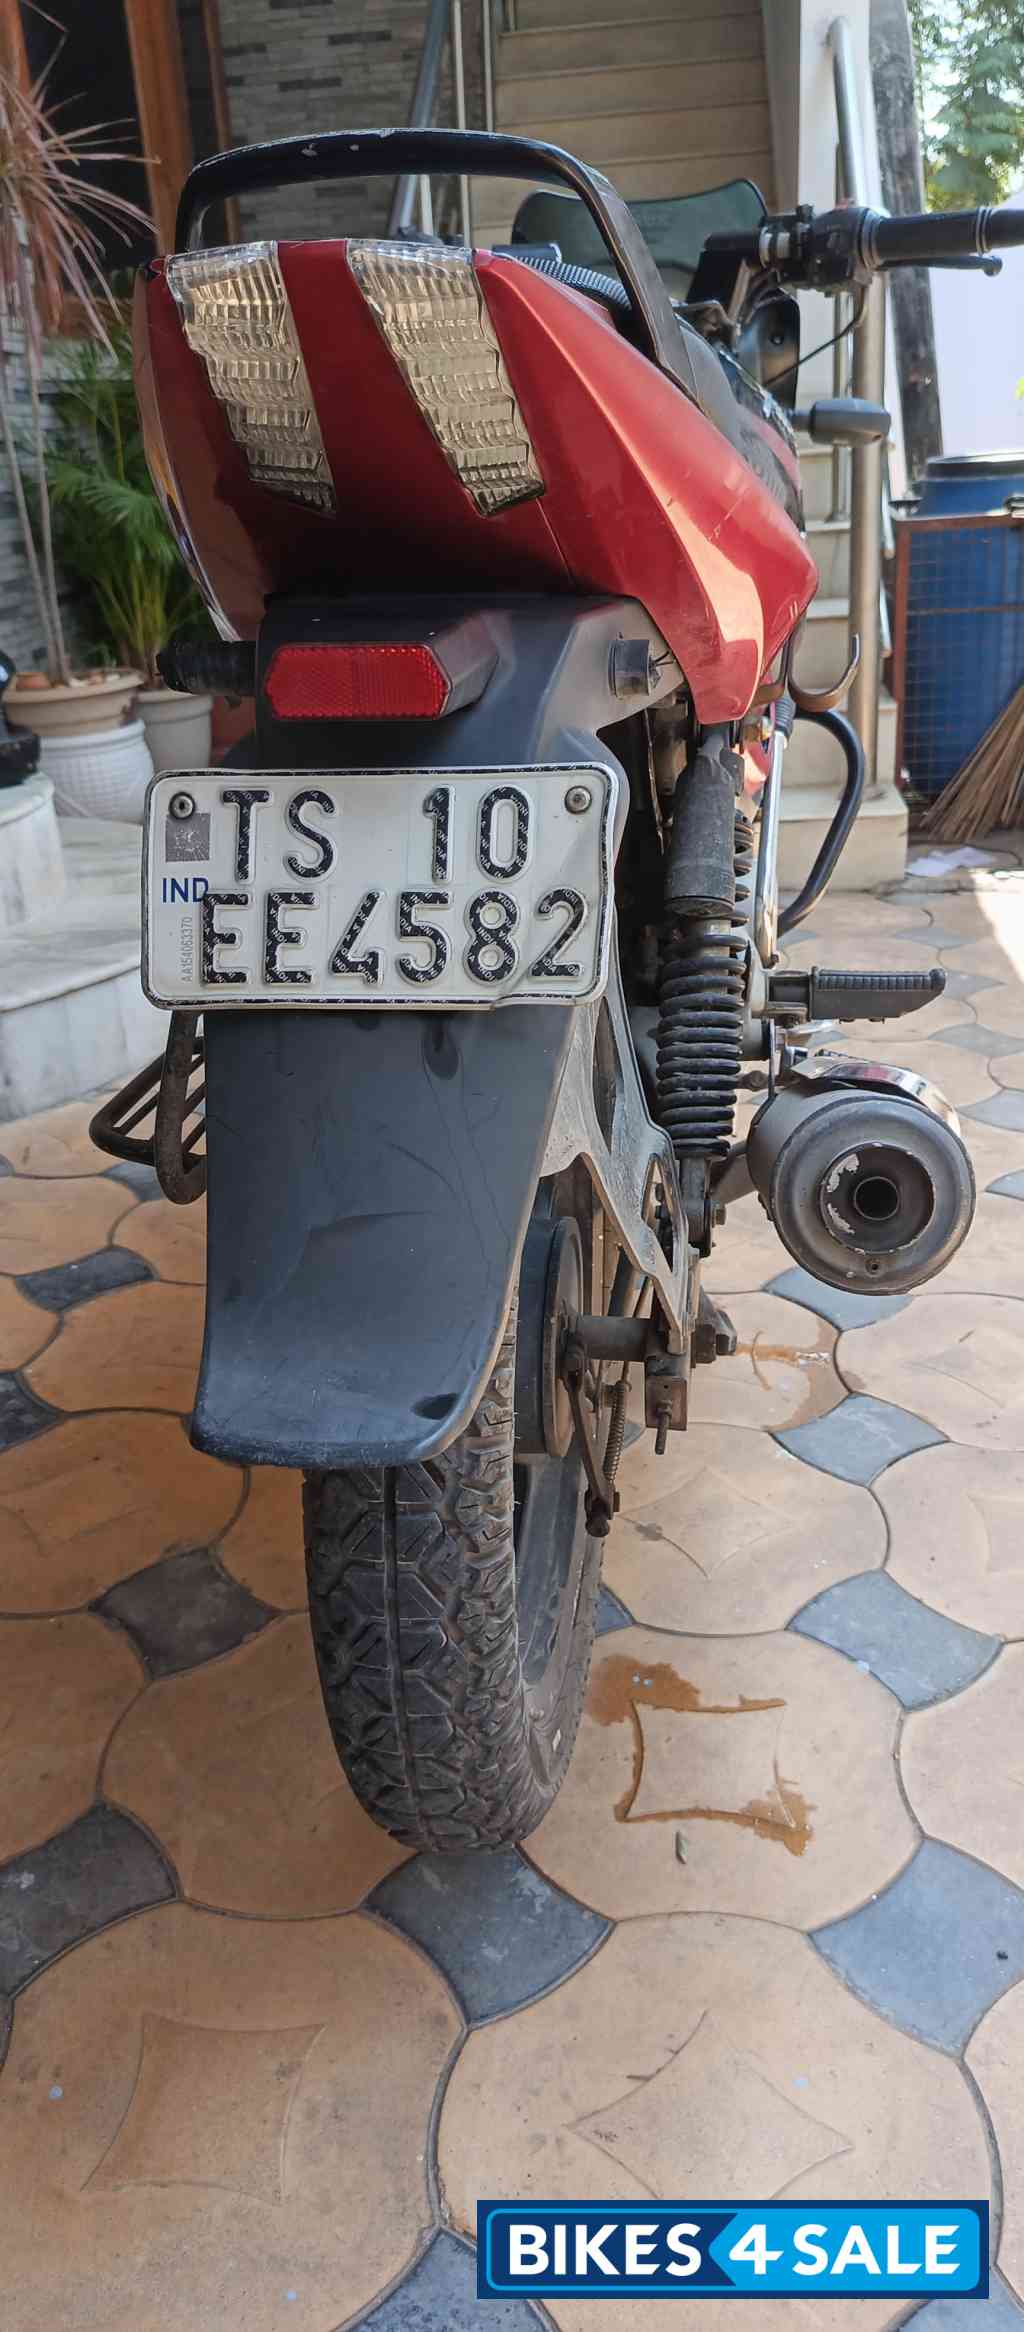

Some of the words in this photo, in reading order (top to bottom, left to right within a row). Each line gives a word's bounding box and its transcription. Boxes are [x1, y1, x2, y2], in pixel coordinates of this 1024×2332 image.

[222, 789, 336, 881] TS
[425, 786, 529, 880] 10
[162, 877, 209, 904] IND
[202, 888, 586, 985] EE4582
